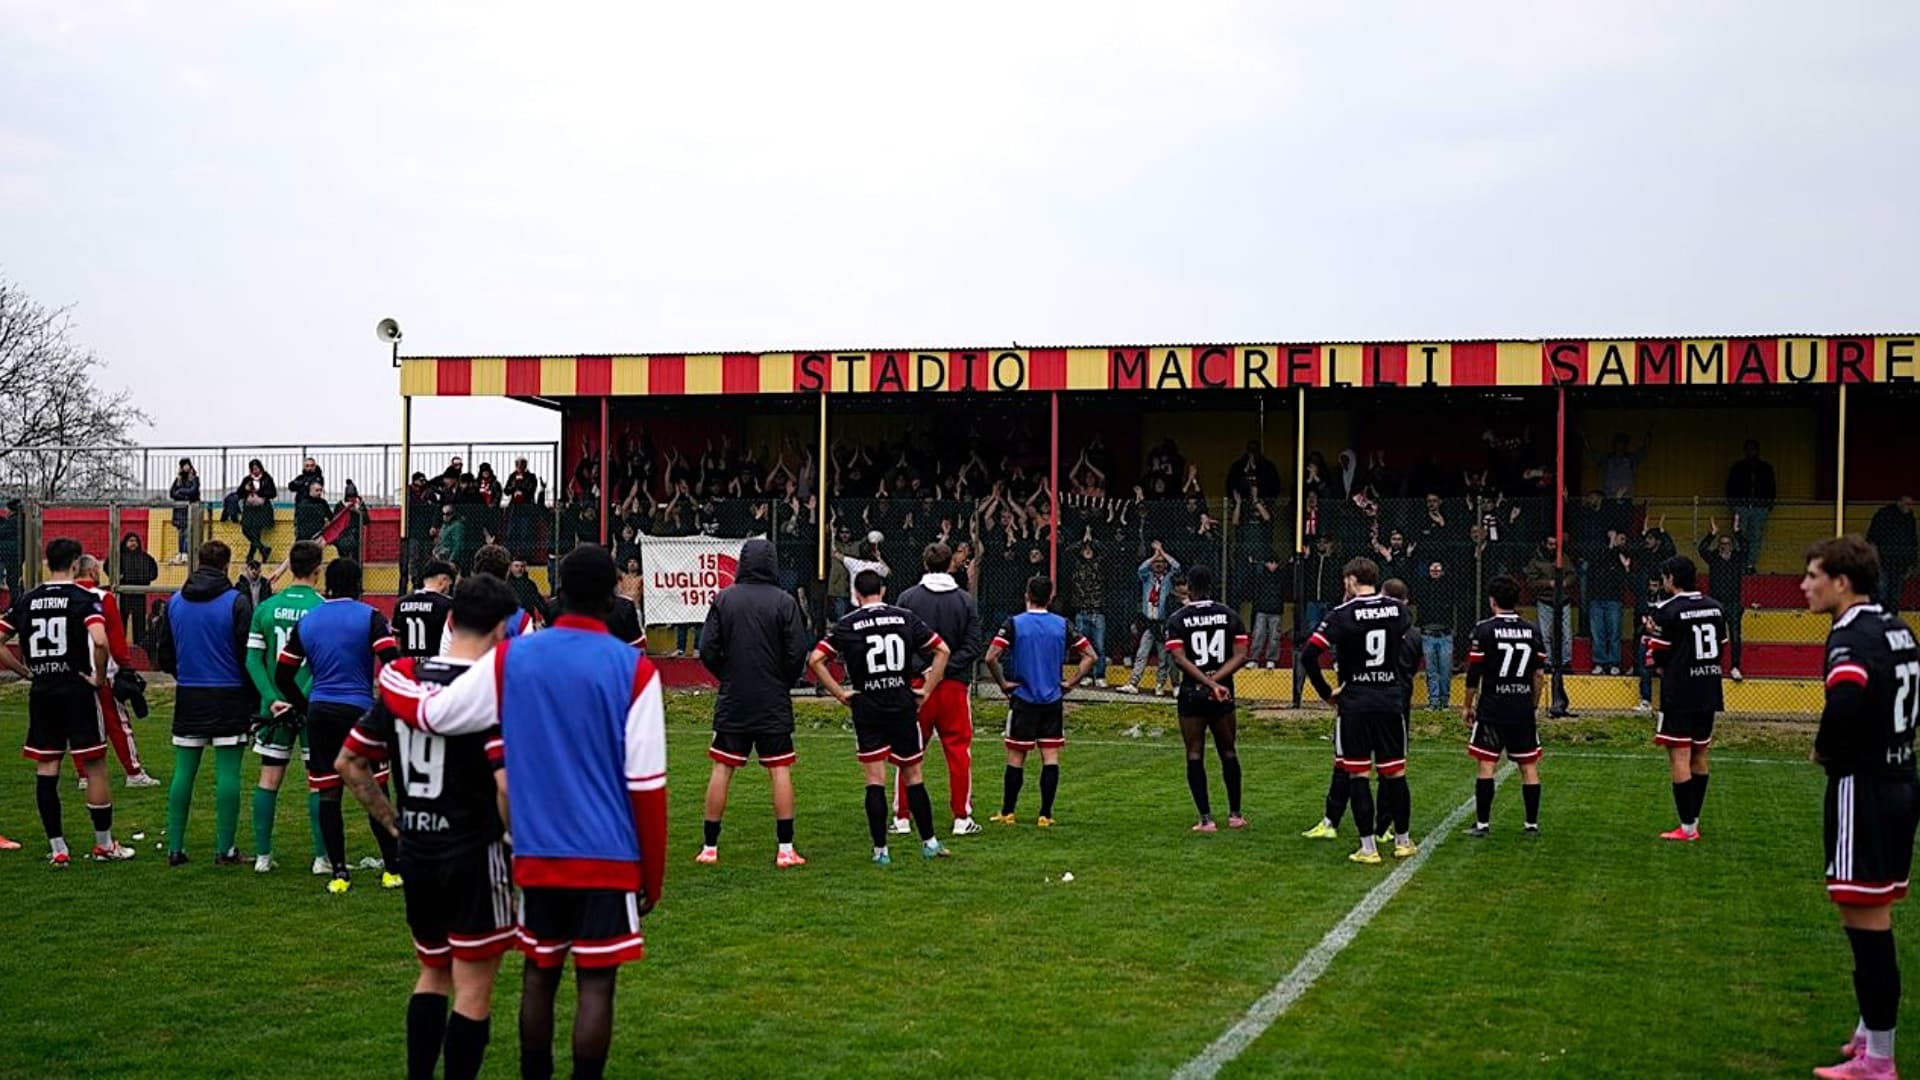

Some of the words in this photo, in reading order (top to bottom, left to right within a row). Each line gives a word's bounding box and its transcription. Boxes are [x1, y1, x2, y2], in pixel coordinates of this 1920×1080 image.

[800, 352, 1025, 391] STADIO
[1113, 347, 1437, 389] MACRELLI
[1550, 340, 1915, 388] SAMMAURE
[699, 553, 716, 569] 15
[655, 572, 717, 588] LUGLIO
[30, 597, 69, 610] BOTRINI
[681, 590, 716, 606] 1913
[1354, 605, 1400, 621] PERSANO
[30, 616, 67, 658] 29
[406, 617, 426, 650] 11
[1494, 628, 1533, 639] MARIANI
[1691, 623, 1719, 660] 13
[866, 633, 906, 674] 20
[1190, 629, 1226, 667] 94
[1365, 629, 1386, 667] 9
[1497, 642, 1532, 677] 77
[30, 661, 70, 675] HATRIA
[864, 676, 905, 691] HATRIA
[1352, 671, 1395, 682] HATRIA
[1495, 683, 1531, 694] HATRIA
[394, 718, 446, 799] 19
